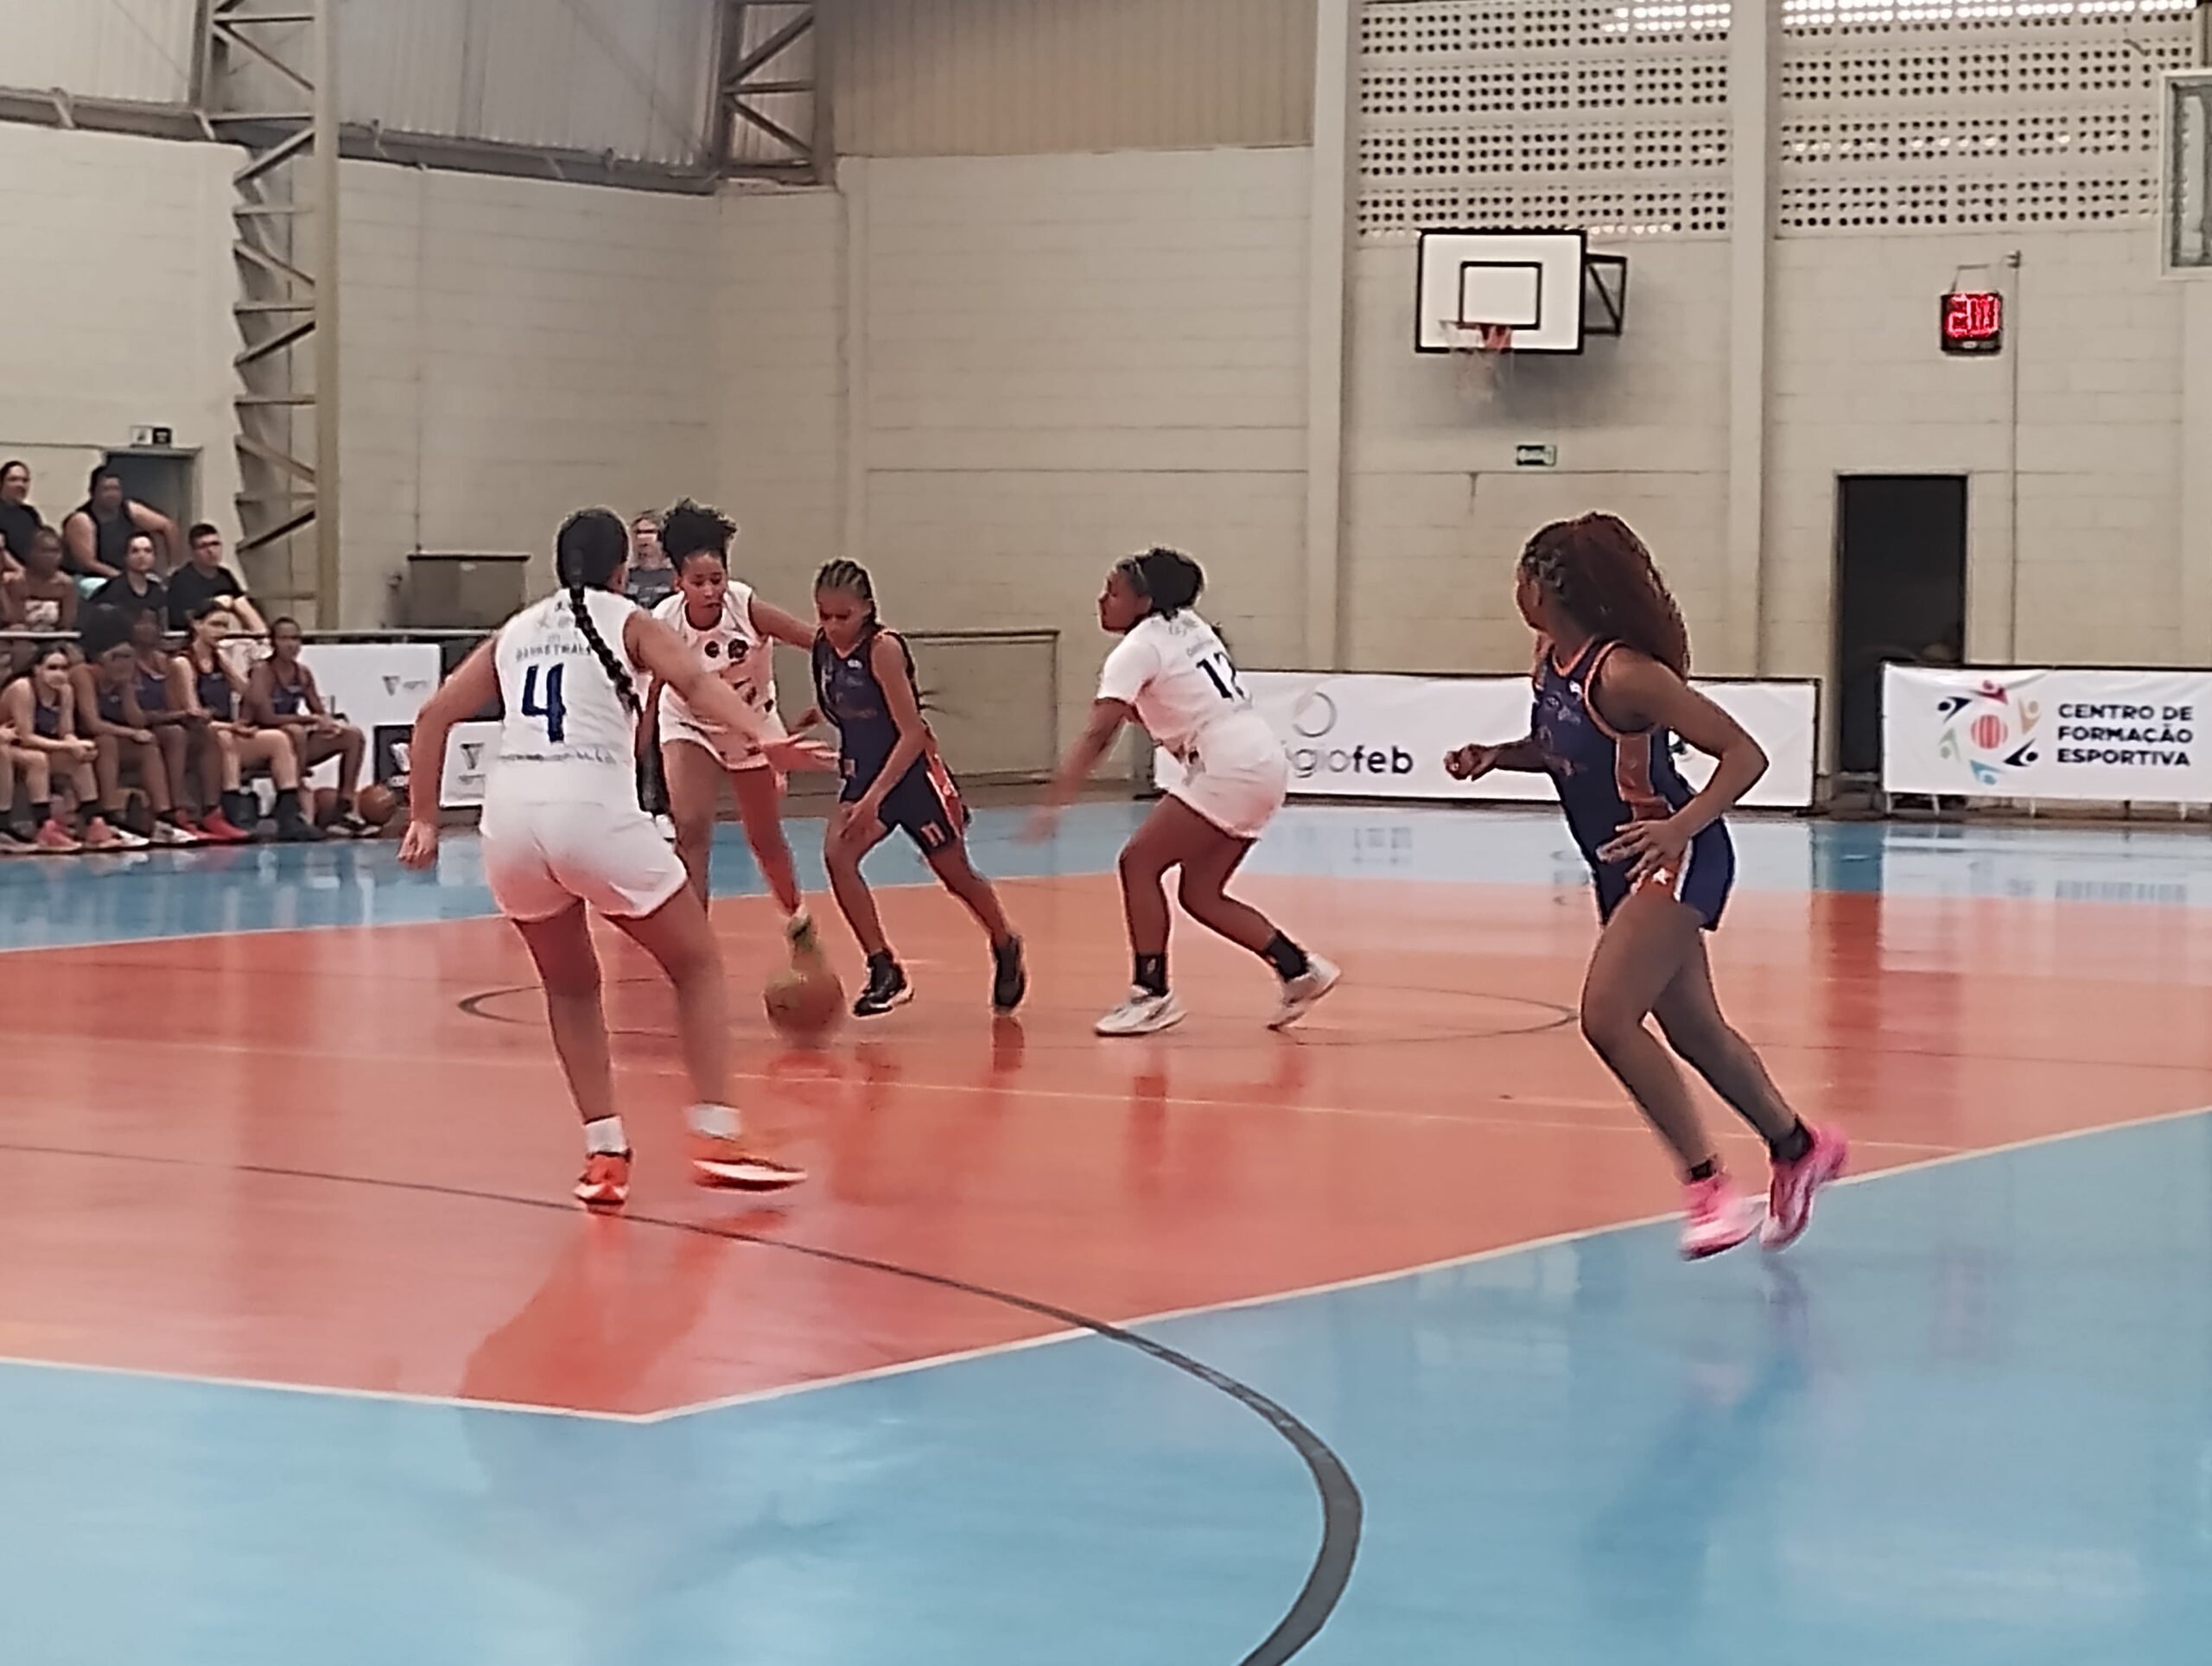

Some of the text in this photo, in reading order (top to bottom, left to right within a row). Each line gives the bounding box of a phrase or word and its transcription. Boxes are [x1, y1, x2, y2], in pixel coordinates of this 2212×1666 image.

[521, 662, 567, 744] 4
[2058, 703, 2193, 721] CENTRO DE
[2057, 723, 2193, 745] FORMAÇÃO
[2057, 748, 2190, 766] ESPORTIVA
